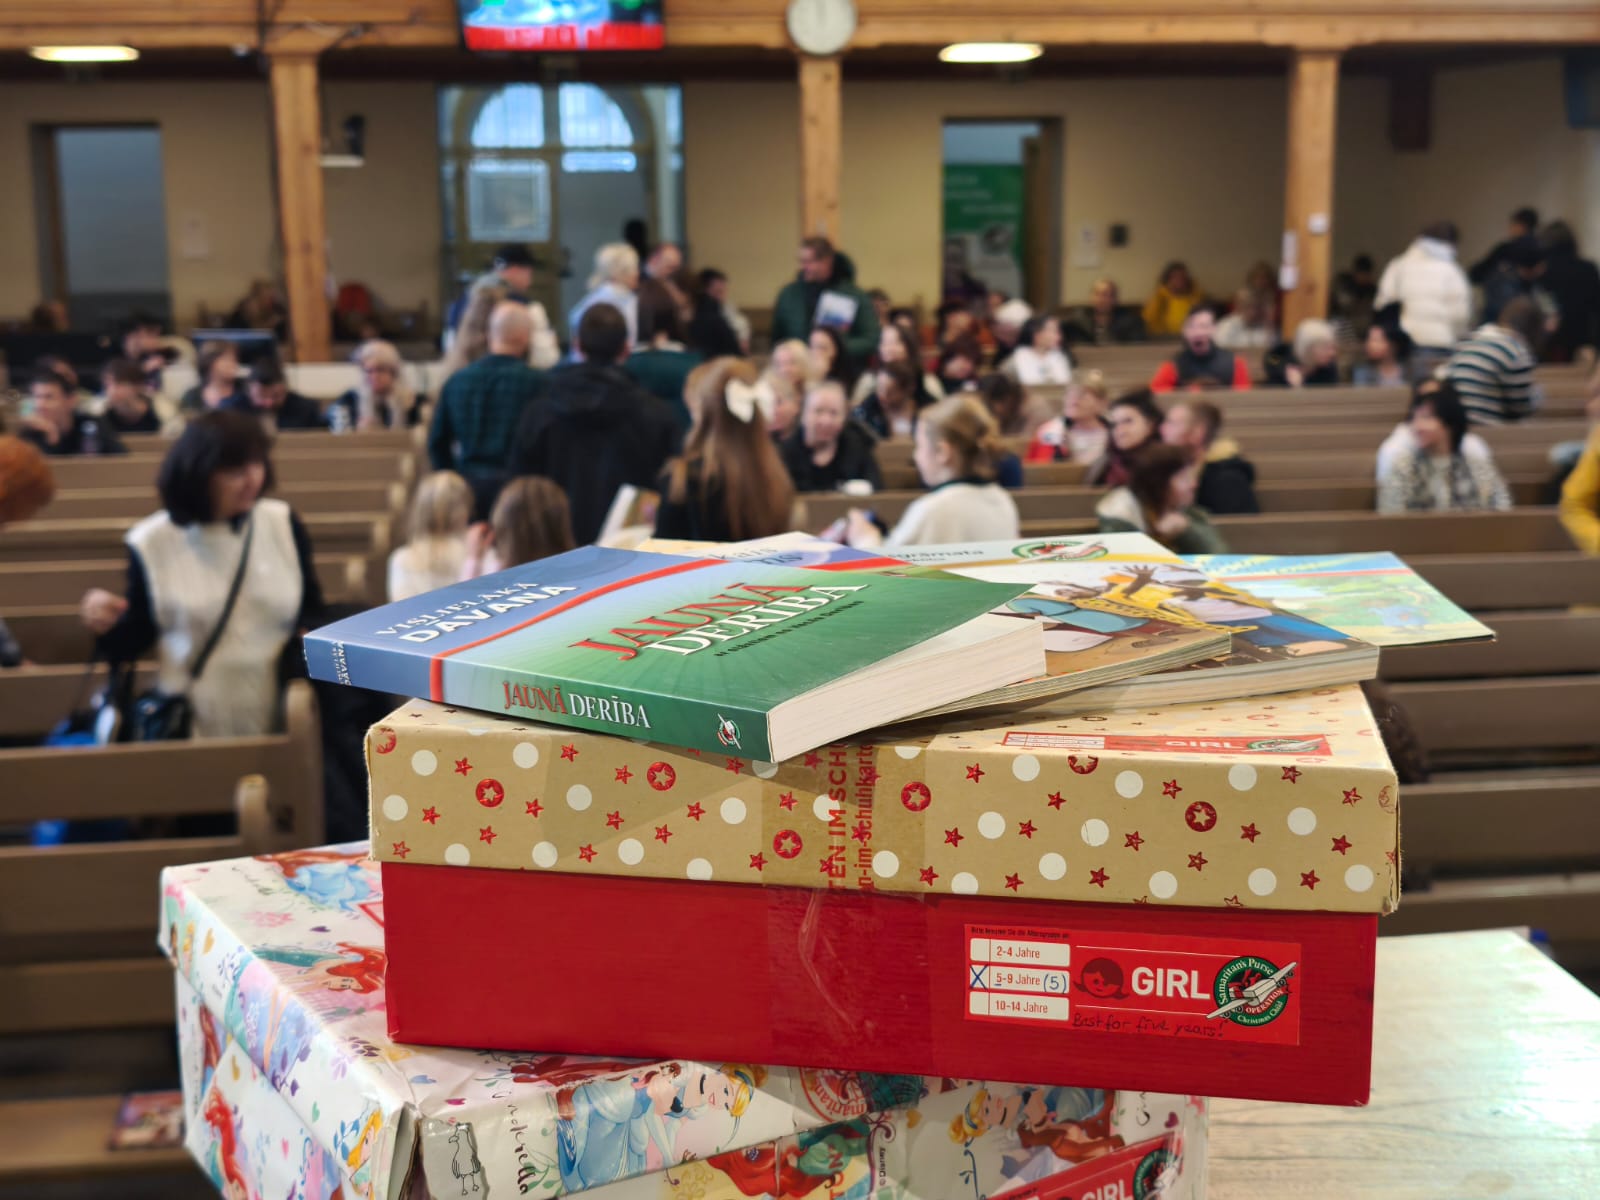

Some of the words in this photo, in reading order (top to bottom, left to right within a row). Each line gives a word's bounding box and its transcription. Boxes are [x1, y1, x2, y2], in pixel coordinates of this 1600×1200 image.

[568, 582, 814, 661] JAUNĀ
[643, 583, 869, 656] DERĪBA
[502, 681, 568, 715] JAUNĀ
[568, 692, 652, 729] DERĪBA
[828, 808, 846, 837] IM
[996, 945, 1012, 957] 2-4
[1016, 947, 1040, 959] Jahre
[996, 972, 1013, 984] 5-9
[1016, 974, 1040, 985] Jahre
[1248, 958, 1274, 976] Purse
[1131, 966, 1210, 1000] GIRL
[996, 1000, 1020, 1011] 10-14
[1024, 1002, 1048, 1013] Jahre
[1245, 987, 1284, 1014] OPERATION
[1105, 1014, 1130, 1032] for
